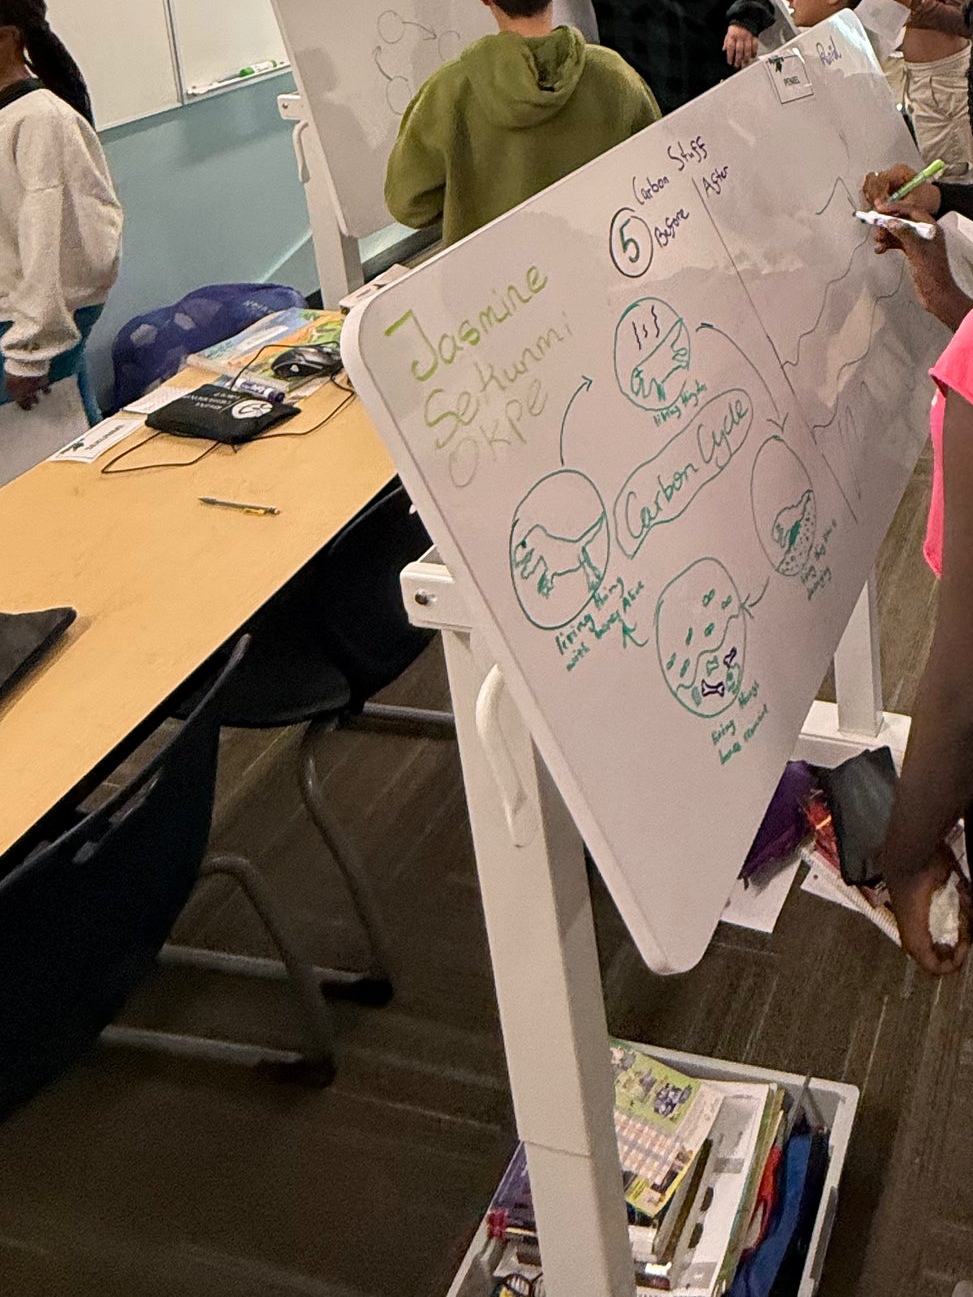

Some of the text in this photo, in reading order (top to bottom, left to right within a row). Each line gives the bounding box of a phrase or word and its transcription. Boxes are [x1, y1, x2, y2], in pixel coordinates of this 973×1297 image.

[632, 135, 708, 206] Carbon Stuff
[653, 208, 690, 249] Before
[384, 264, 548, 382] Jasmine
[625, 399, 750, 540] Carbon Cycle
